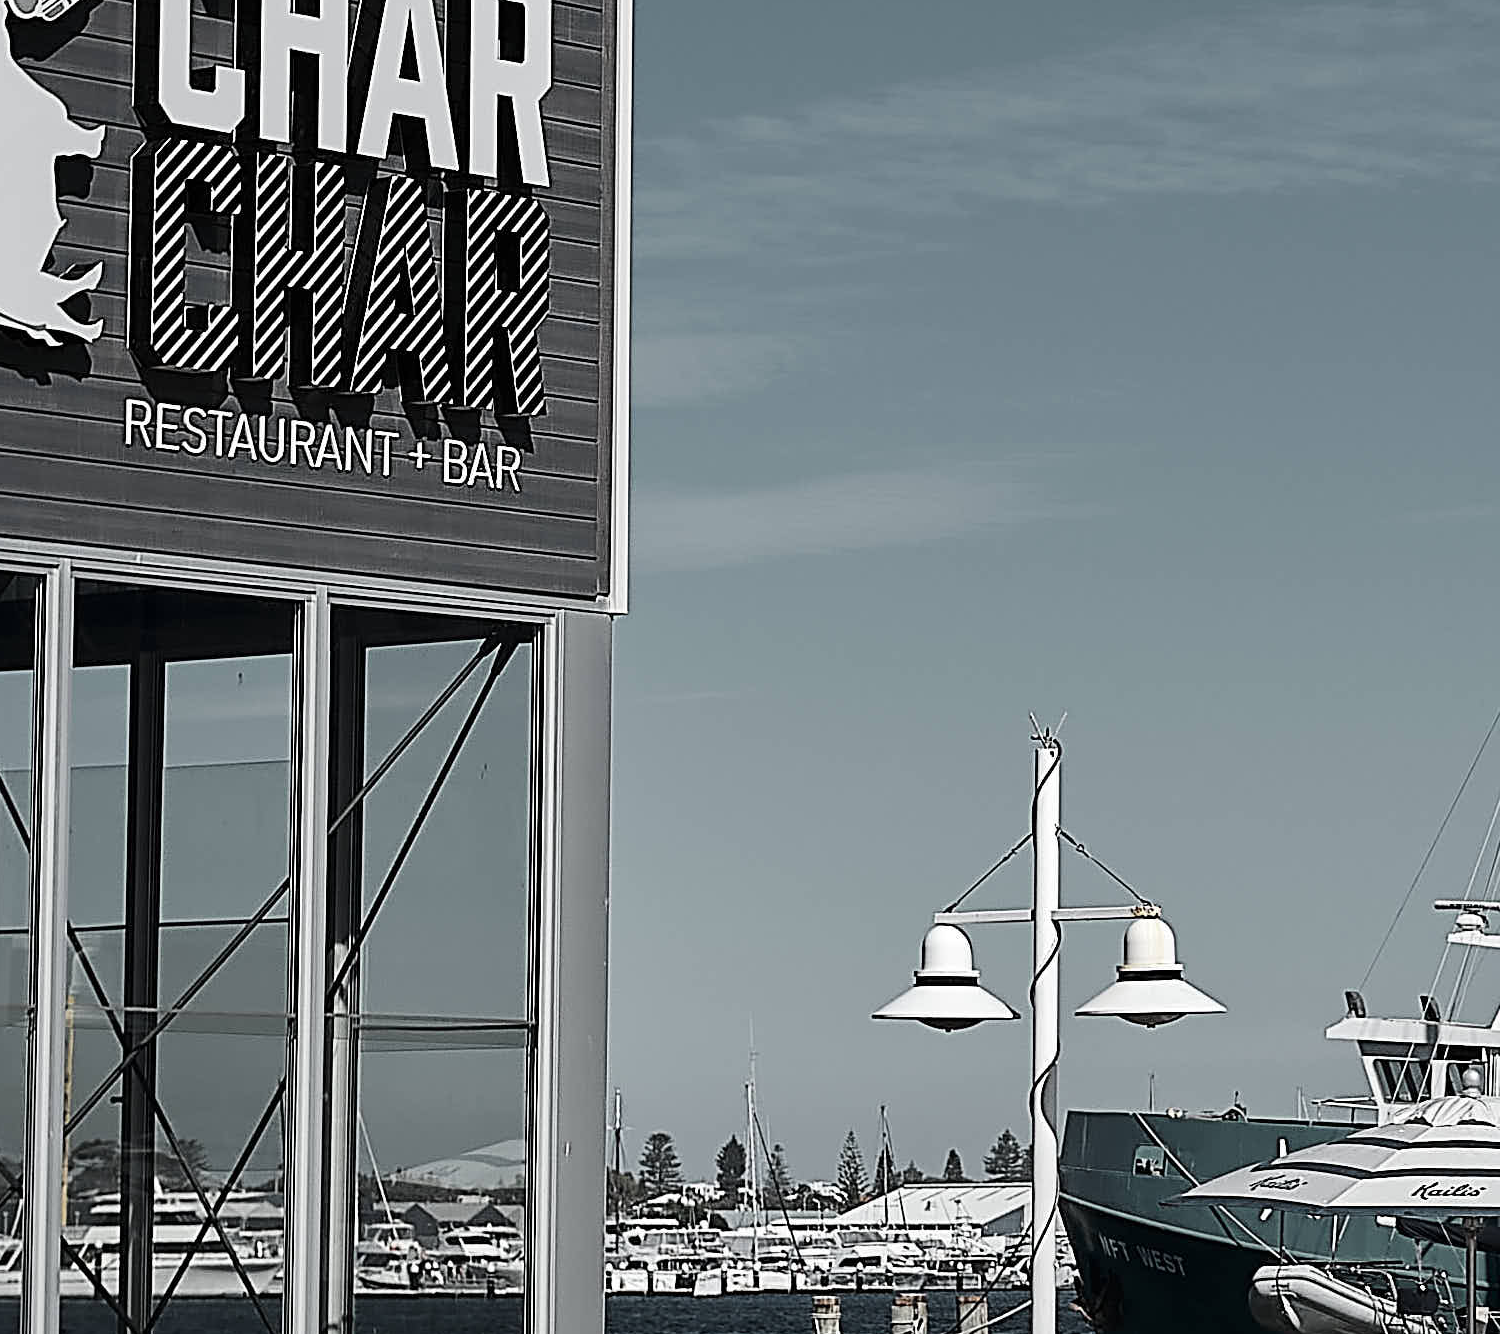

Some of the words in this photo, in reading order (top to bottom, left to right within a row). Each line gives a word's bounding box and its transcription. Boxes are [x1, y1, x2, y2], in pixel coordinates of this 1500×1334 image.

[148, 137, 551, 416] CHAR
[123, 398, 399, 476] RESTAURANT
[442, 445, 521, 492] BAR
[1136, 1244, 1186, 1276] WEST
